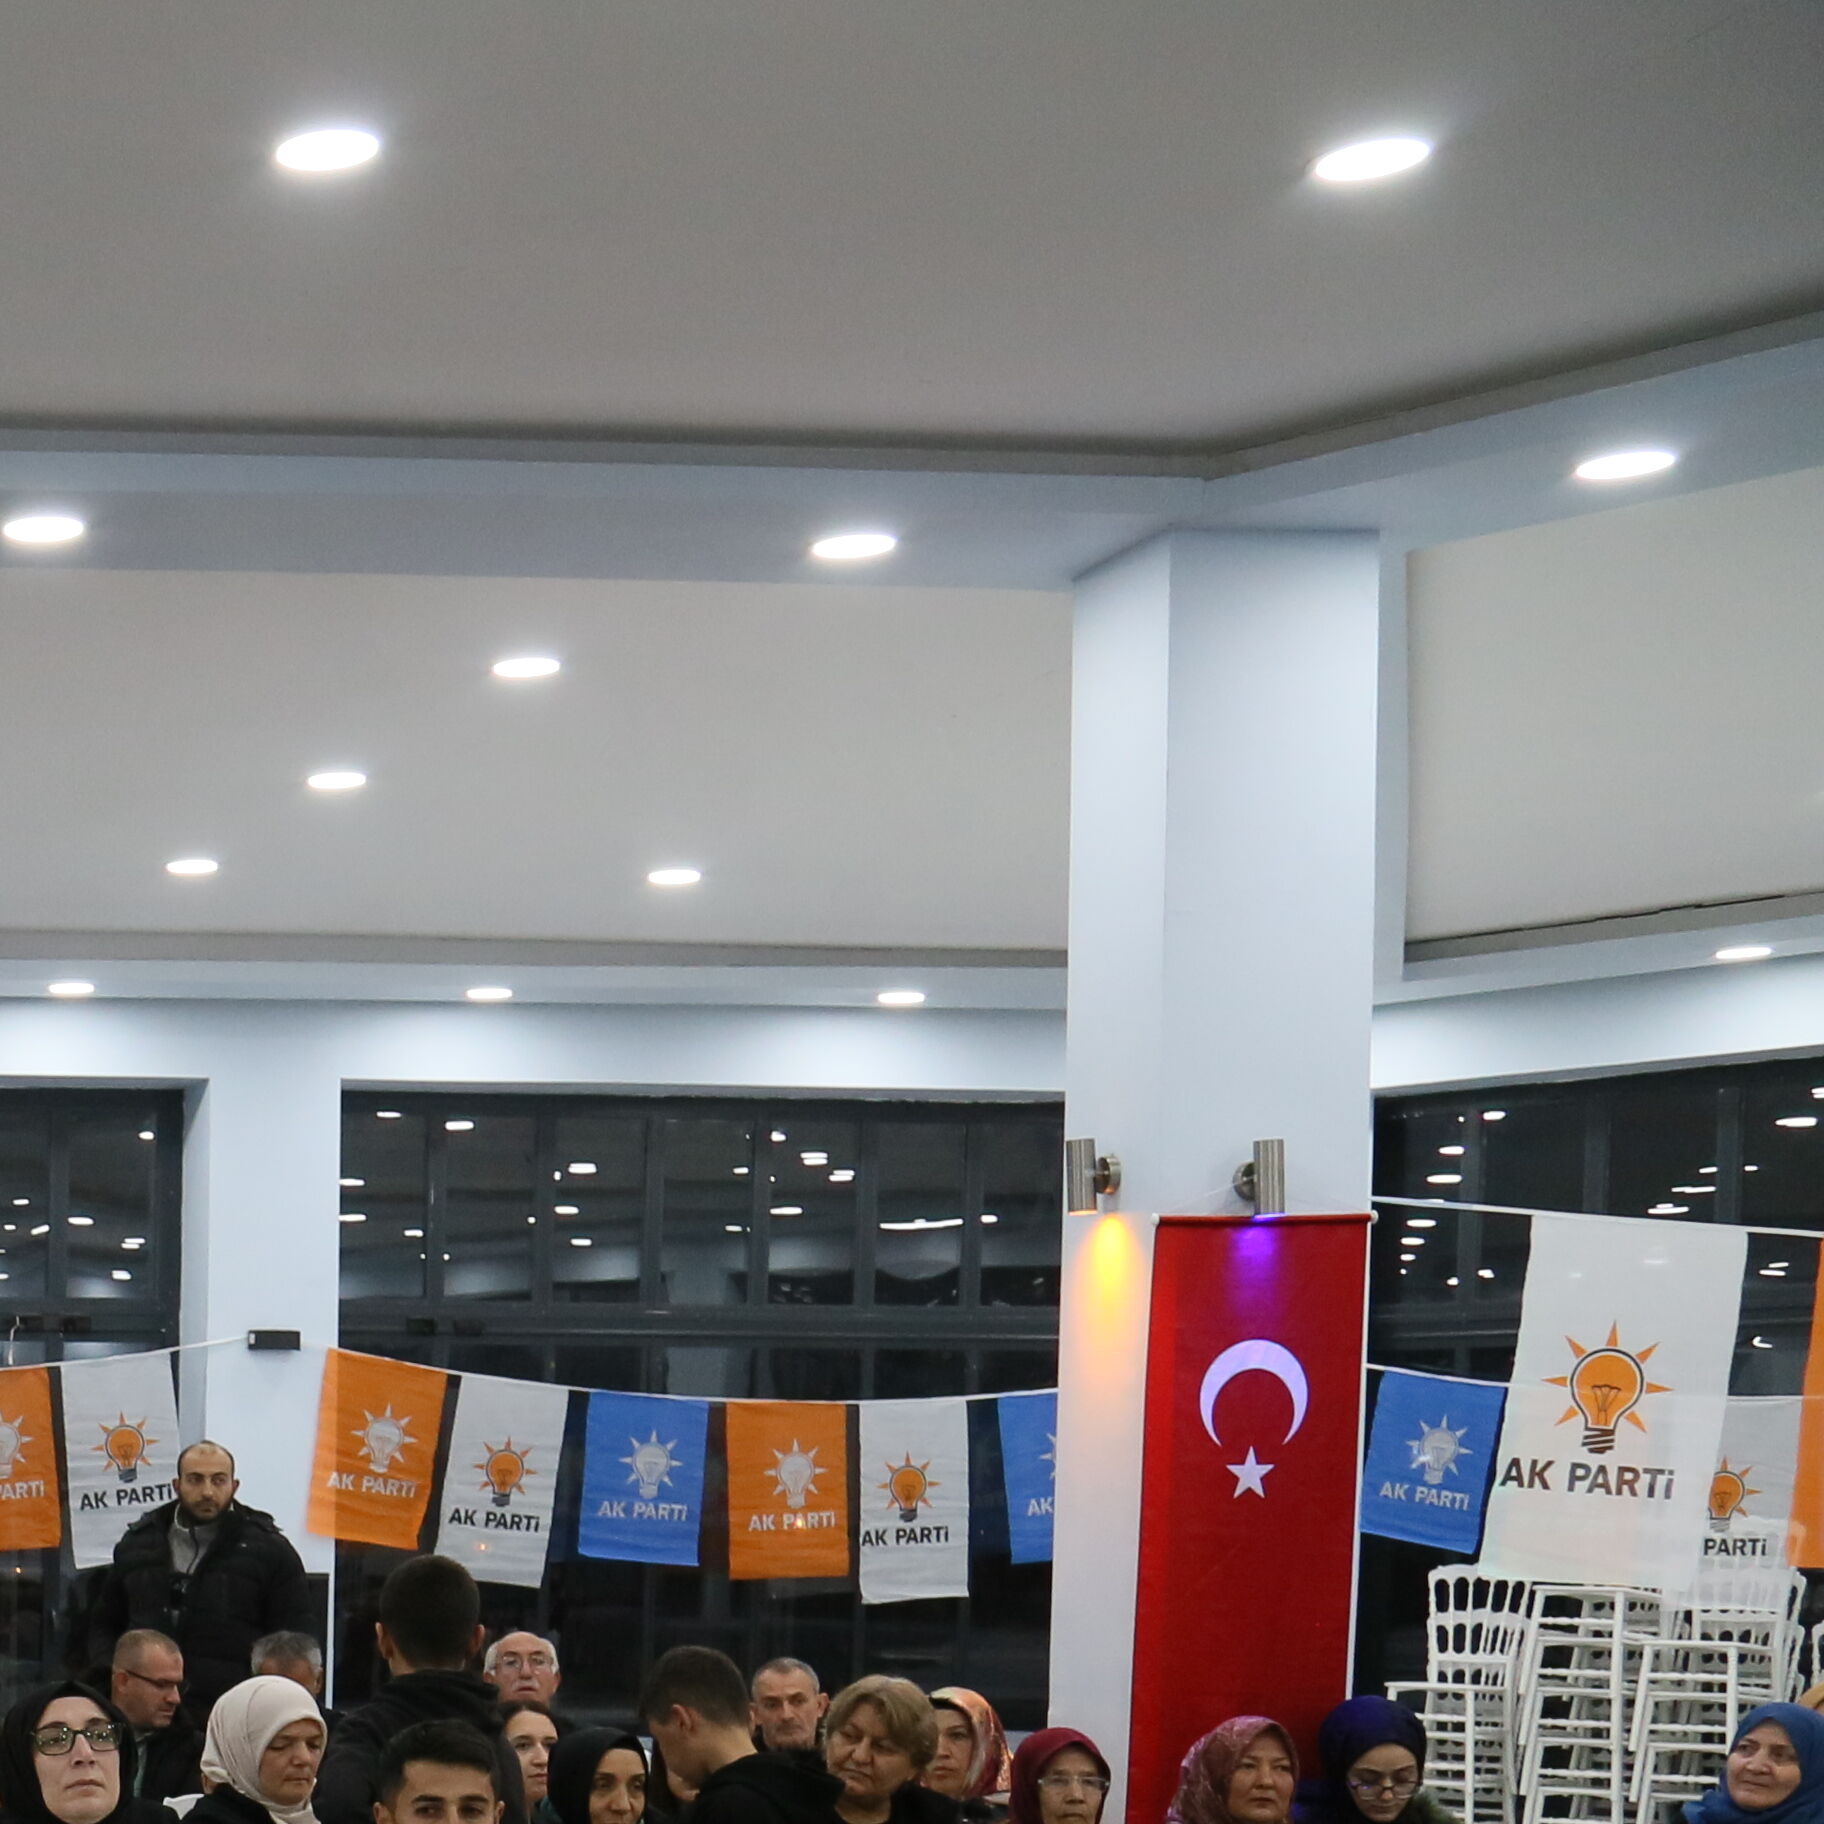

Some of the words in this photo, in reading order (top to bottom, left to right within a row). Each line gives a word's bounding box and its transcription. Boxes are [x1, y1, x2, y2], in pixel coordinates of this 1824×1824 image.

[327, 1471, 354, 1490] AK
[1499, 1458, 1555, 1490] AK
[79, 1490, 109, 1512] AK
[1380, 1482, 1408, 1502] AK
[448, 1508, 477, 1528] AK
[597, 1501, 626, 1519] AK
[748, 1514, 775, 1531] AK
[861, 1528, 887, 1546] AK
